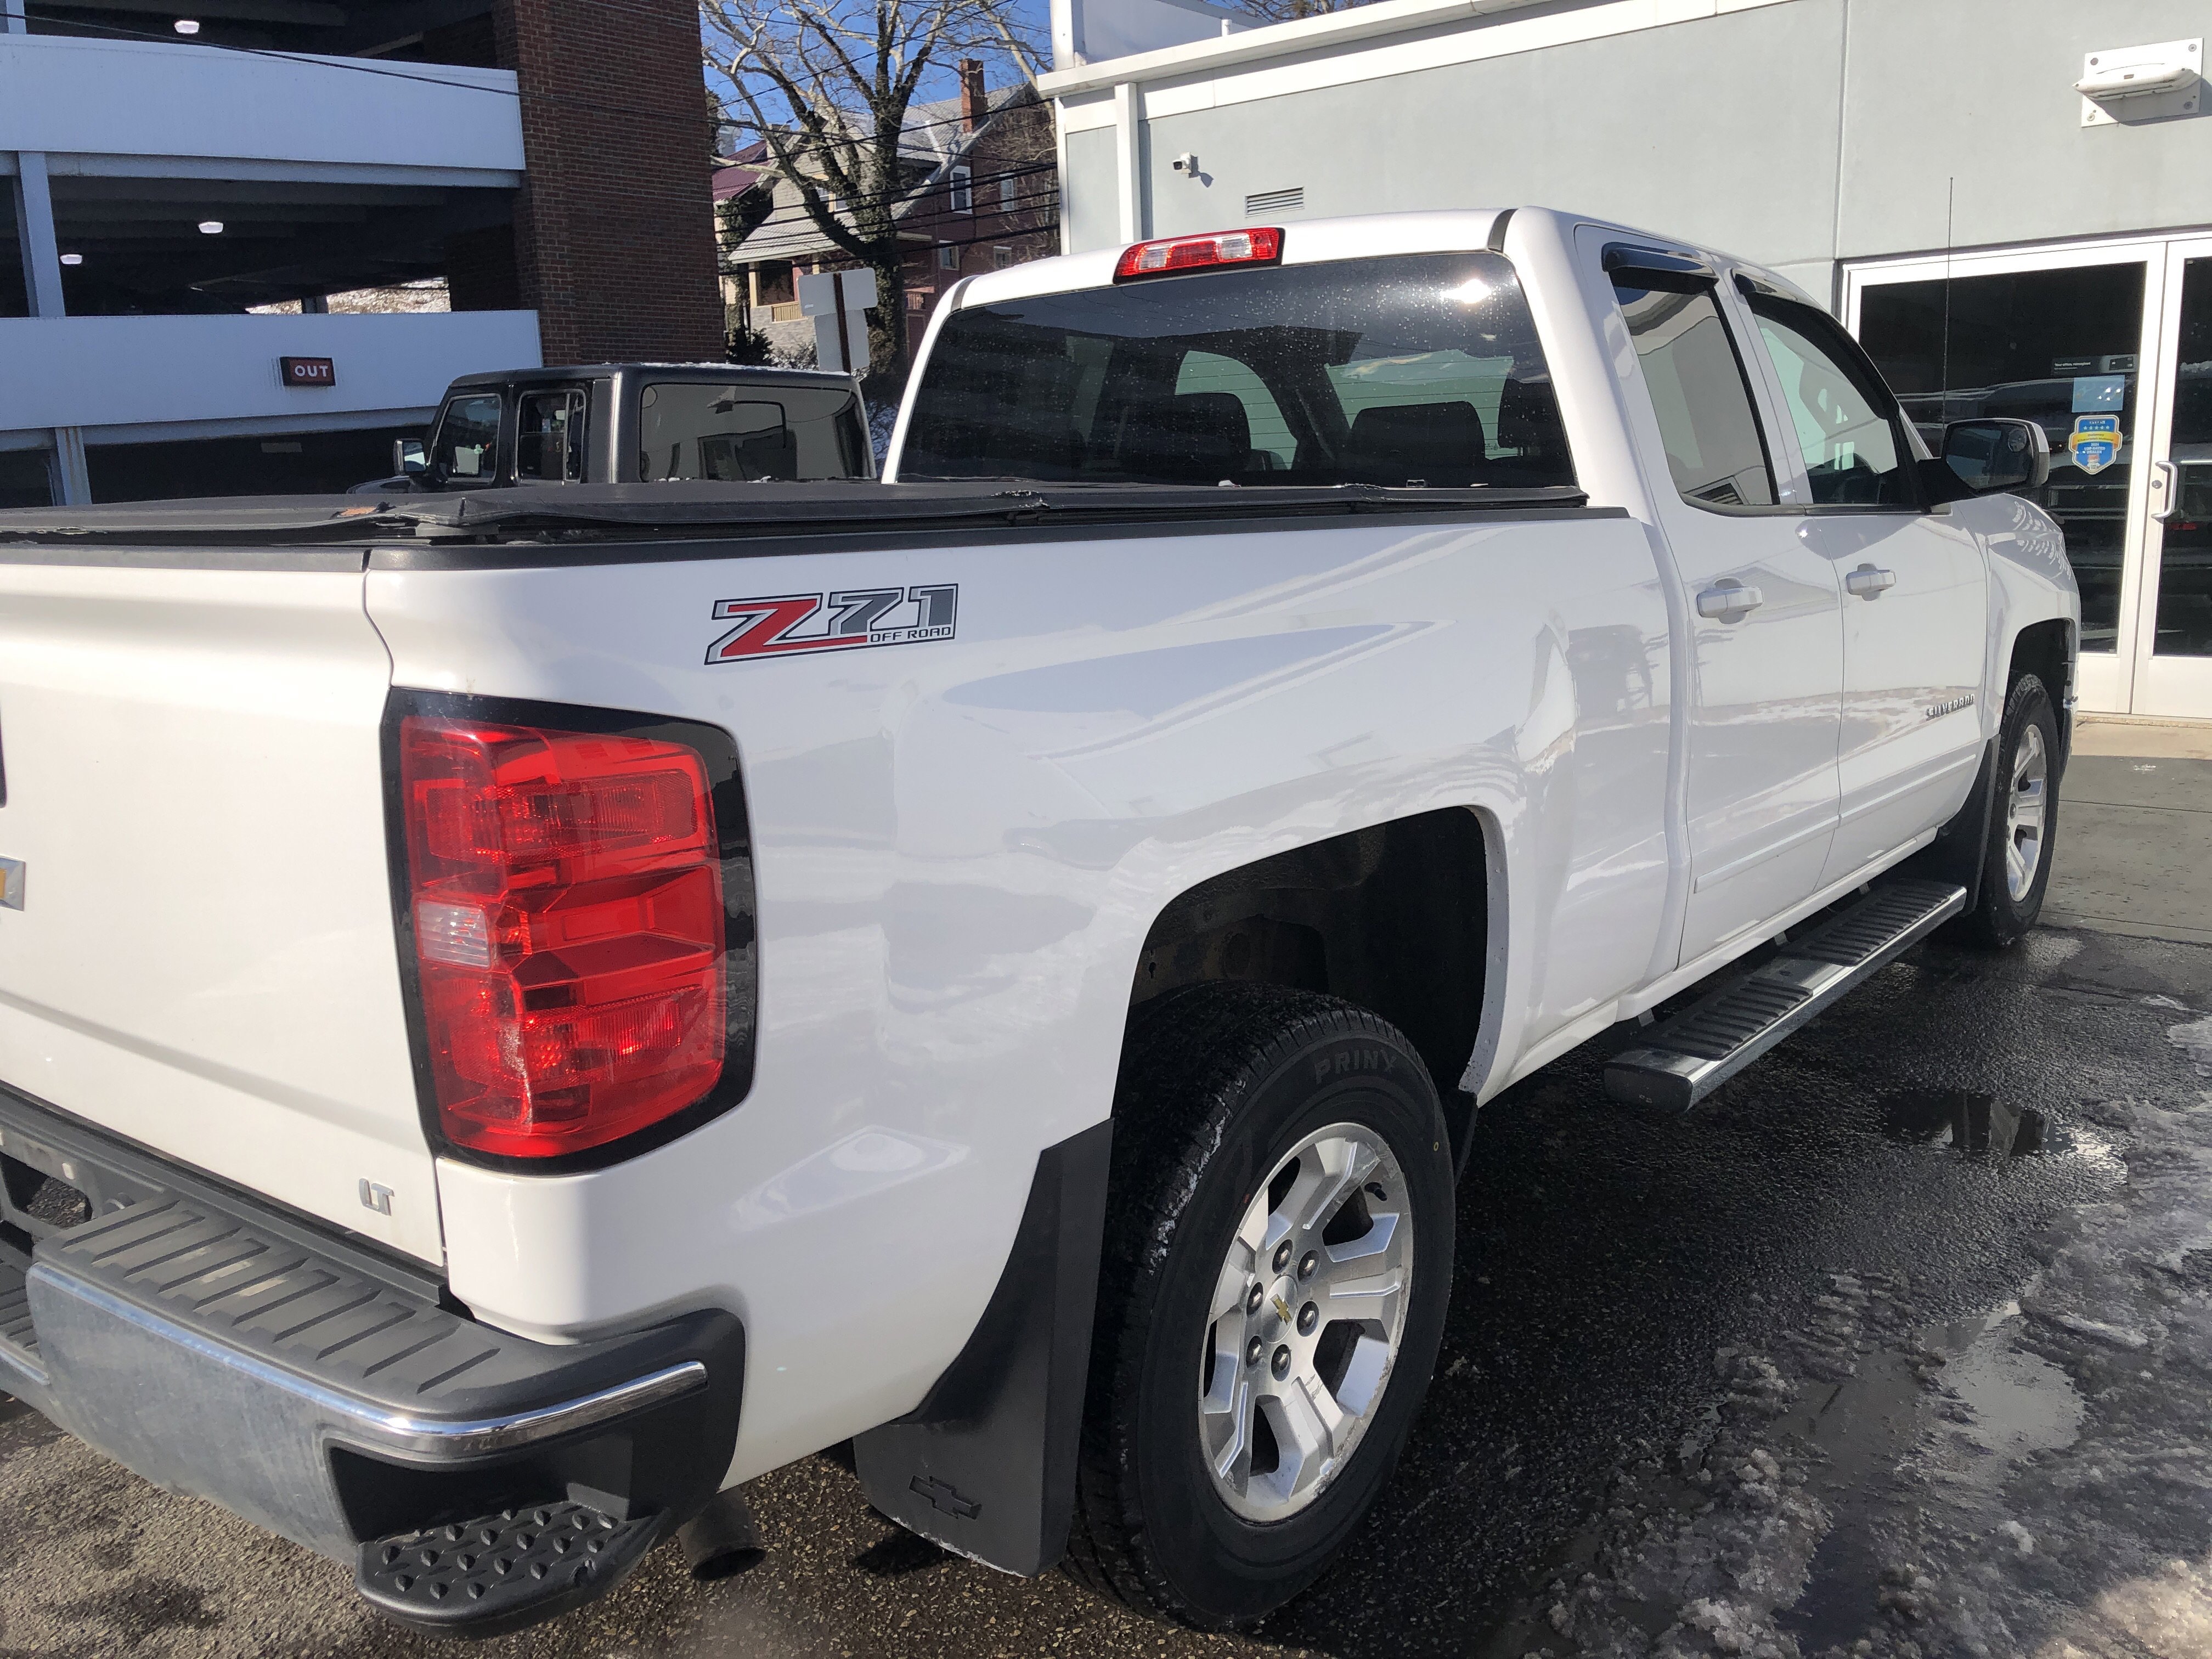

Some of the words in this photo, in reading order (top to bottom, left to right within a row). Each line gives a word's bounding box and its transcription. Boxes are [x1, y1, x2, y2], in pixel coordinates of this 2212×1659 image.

[295, 365, 328, 377] OUT
[704, 583, 959, 665] Z71
[870, 631, 903, 643] OFF
[907, 626, 951, 639] ROAD
[1315, 1048, 1397, 1085] PRINX
[358, 1178, 395, 1216] LT
